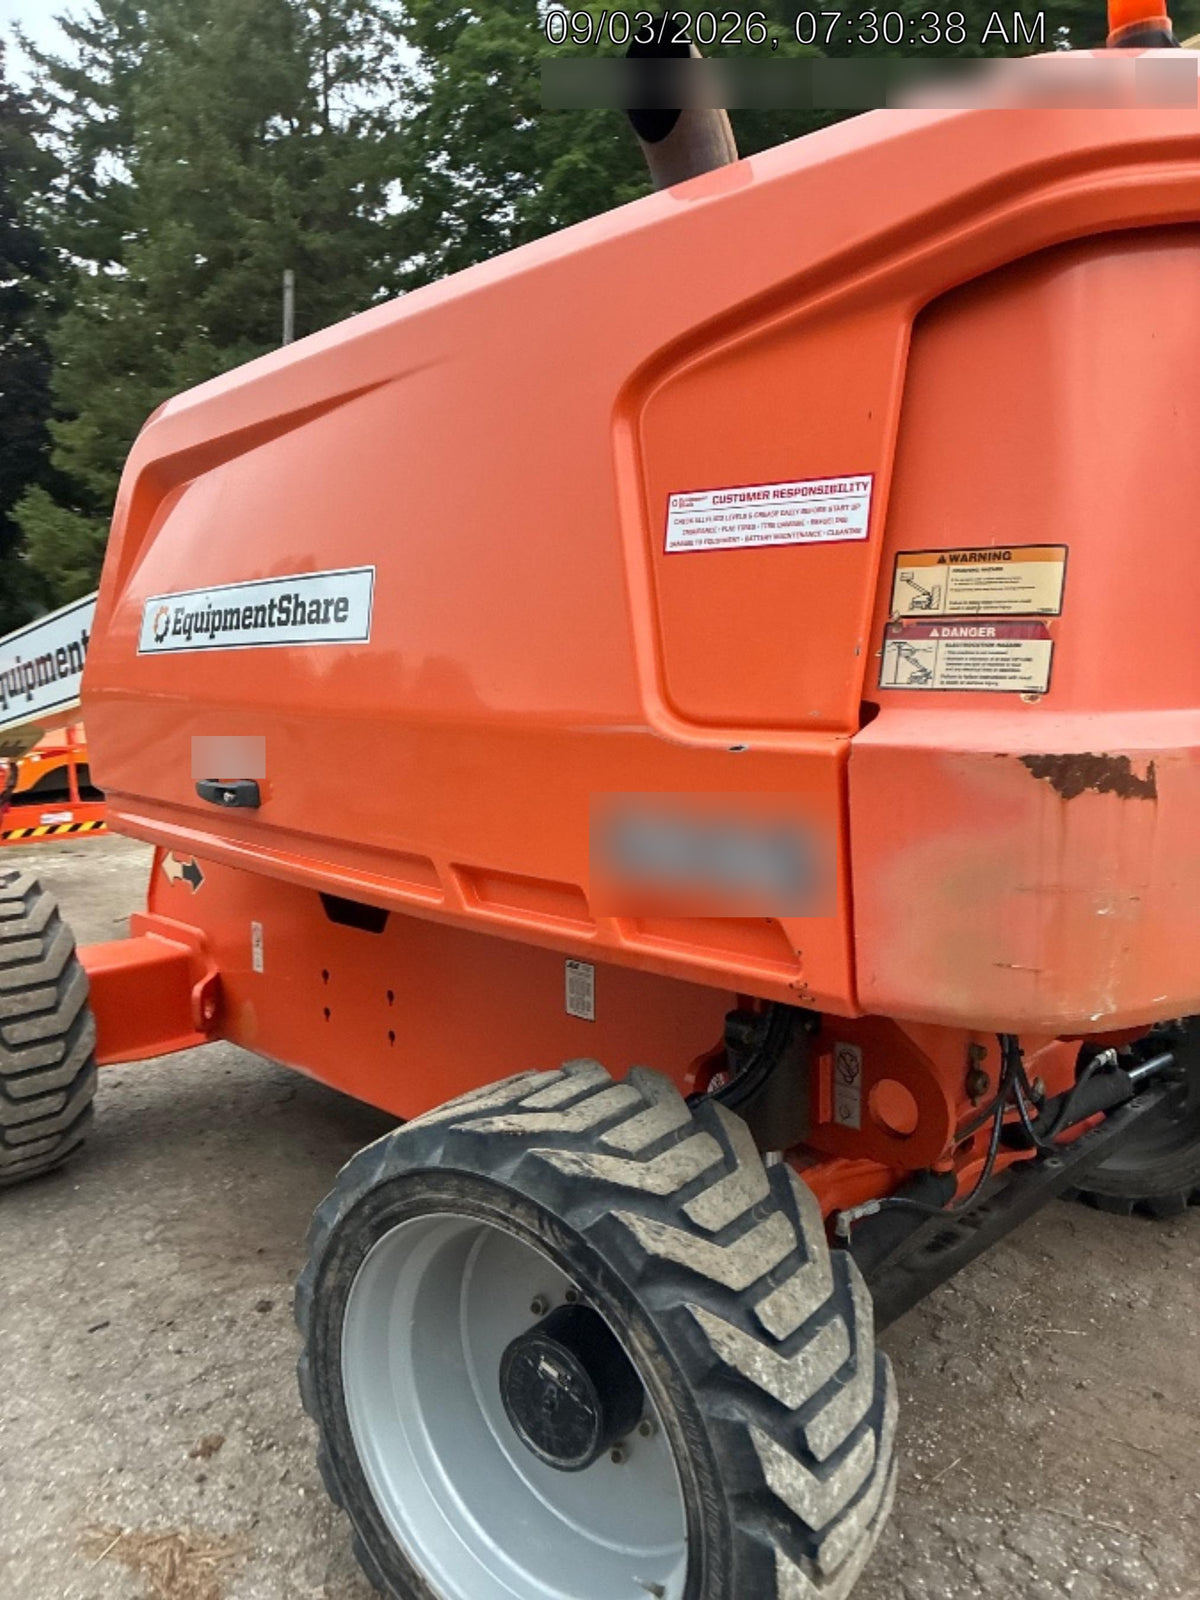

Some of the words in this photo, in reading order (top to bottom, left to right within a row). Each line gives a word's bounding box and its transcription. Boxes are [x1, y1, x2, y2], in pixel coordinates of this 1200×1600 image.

[712, 490, 771, 506] CUSTOMER
[773, 481, 869, 500] RESPONSIBILITY
[949, 551, 1012, 563] WARNING
[172, 593, 350, 640] EquipmentShare
[941, 627, 996, 638] DANGER
